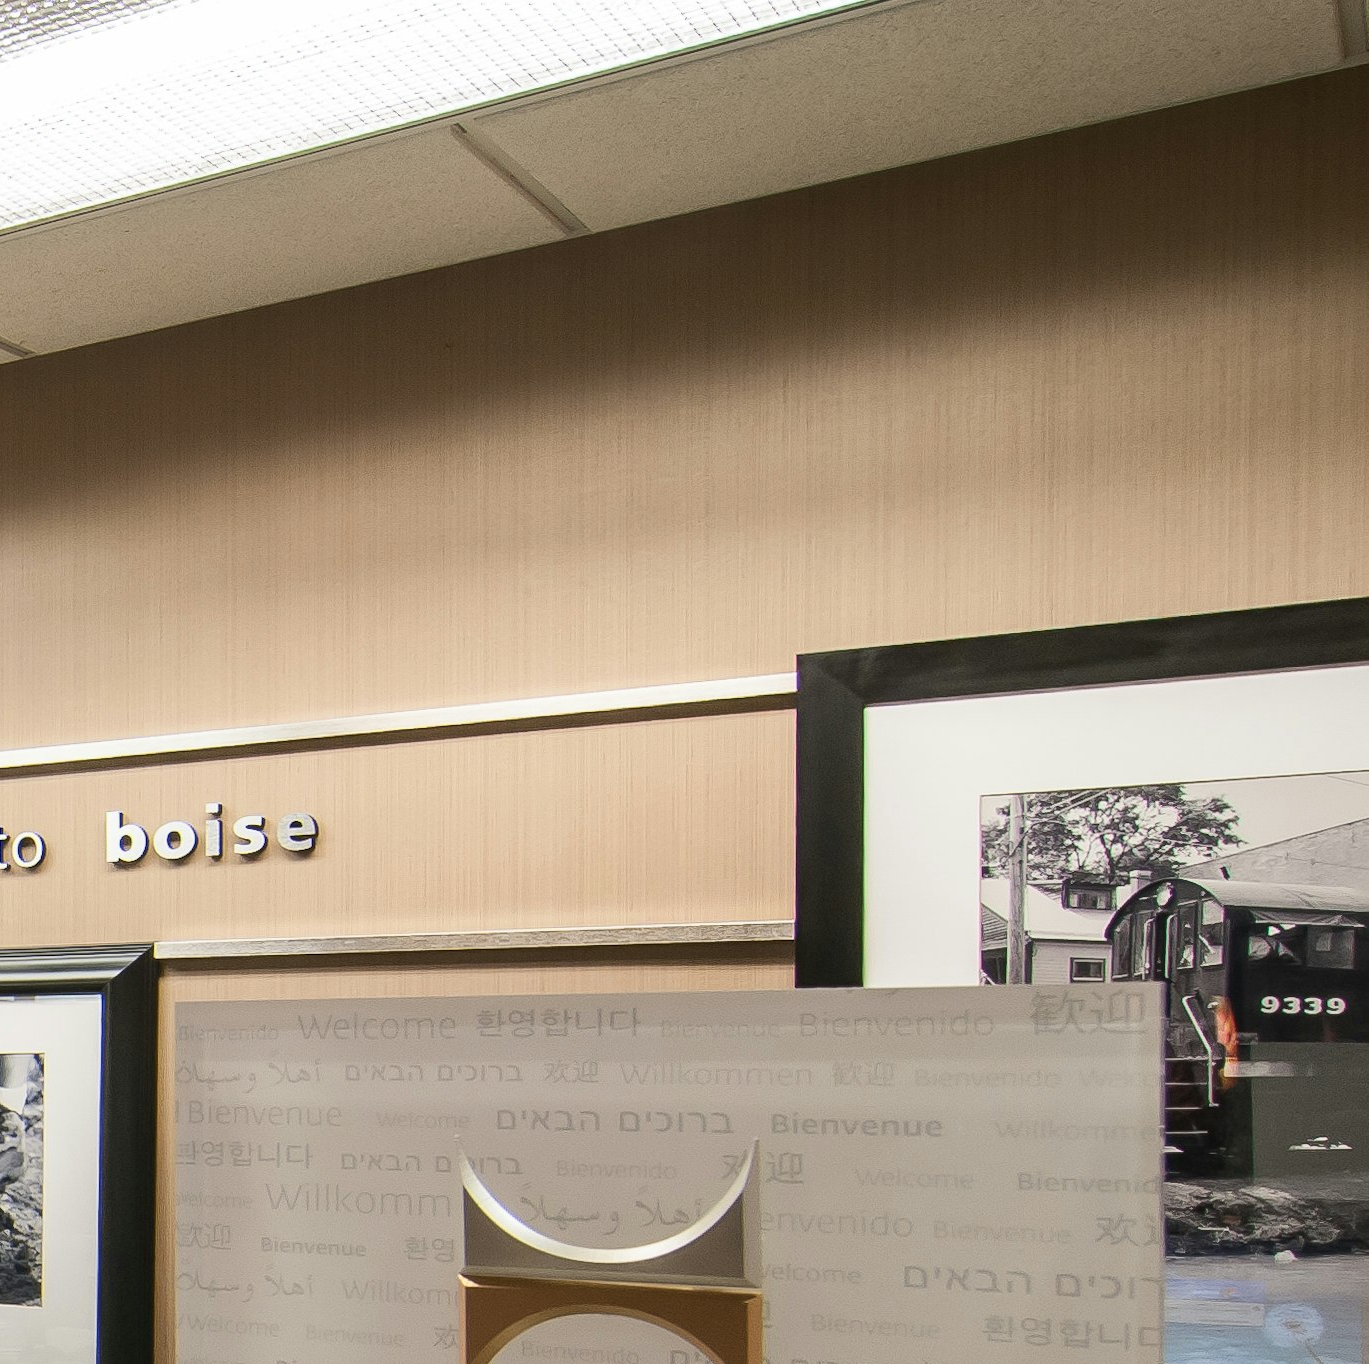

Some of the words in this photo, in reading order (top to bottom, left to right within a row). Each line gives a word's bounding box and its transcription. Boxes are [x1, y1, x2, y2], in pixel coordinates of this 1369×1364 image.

[105, 802, 319, 866] boise
[1259, 995, 1348, 1016] 9339
[297, 1012, 458, 1041] Welcome
[799, 1009, 995, 1039] Bienvenido
[620, 1062, 813, 1088] Willkommen
[187, 1100, 343, 1128] Bienvenue
[771, 1112, 943, 1138] Bienvenue
[261, 1236, 368, 1258] Bienvenue
